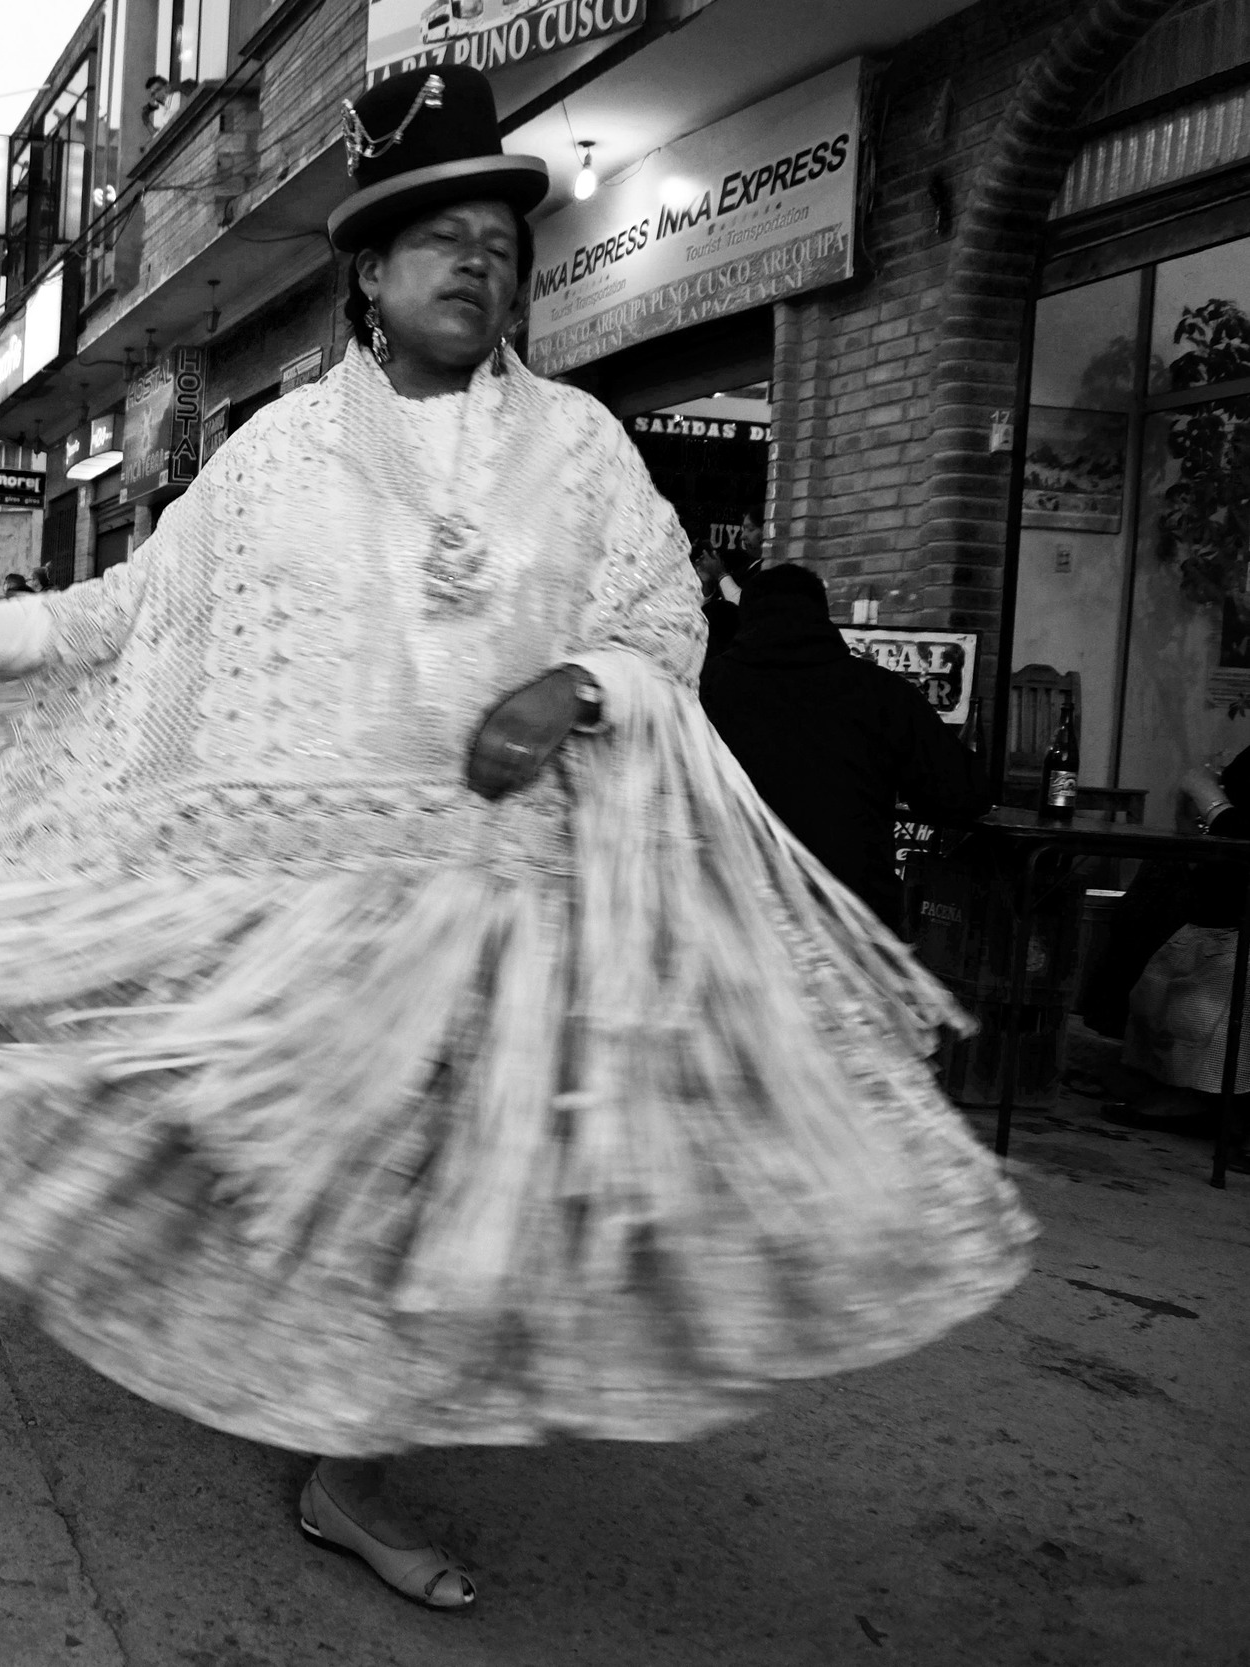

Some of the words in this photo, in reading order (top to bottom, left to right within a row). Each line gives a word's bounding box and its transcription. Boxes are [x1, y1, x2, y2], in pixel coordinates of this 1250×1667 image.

[656, 189, 712, 240] INKA
[717, 133, 850, 216] EXPRESS
[533, 261, 568, 301] INKA
[571, 218, 650, 284] EXPRESS
[686, 236, 721, 262] Tourist
[727, 206, 810, 246] Transportation
[126, 359, 174, 411] HOSTAL
[172, 349, 202, 482] HOSTAL
[634, 416, 738, 440] SALIDAS
[990, 410, 1010, 424] 17
[921, 900, 963, 923] PACEÑA
